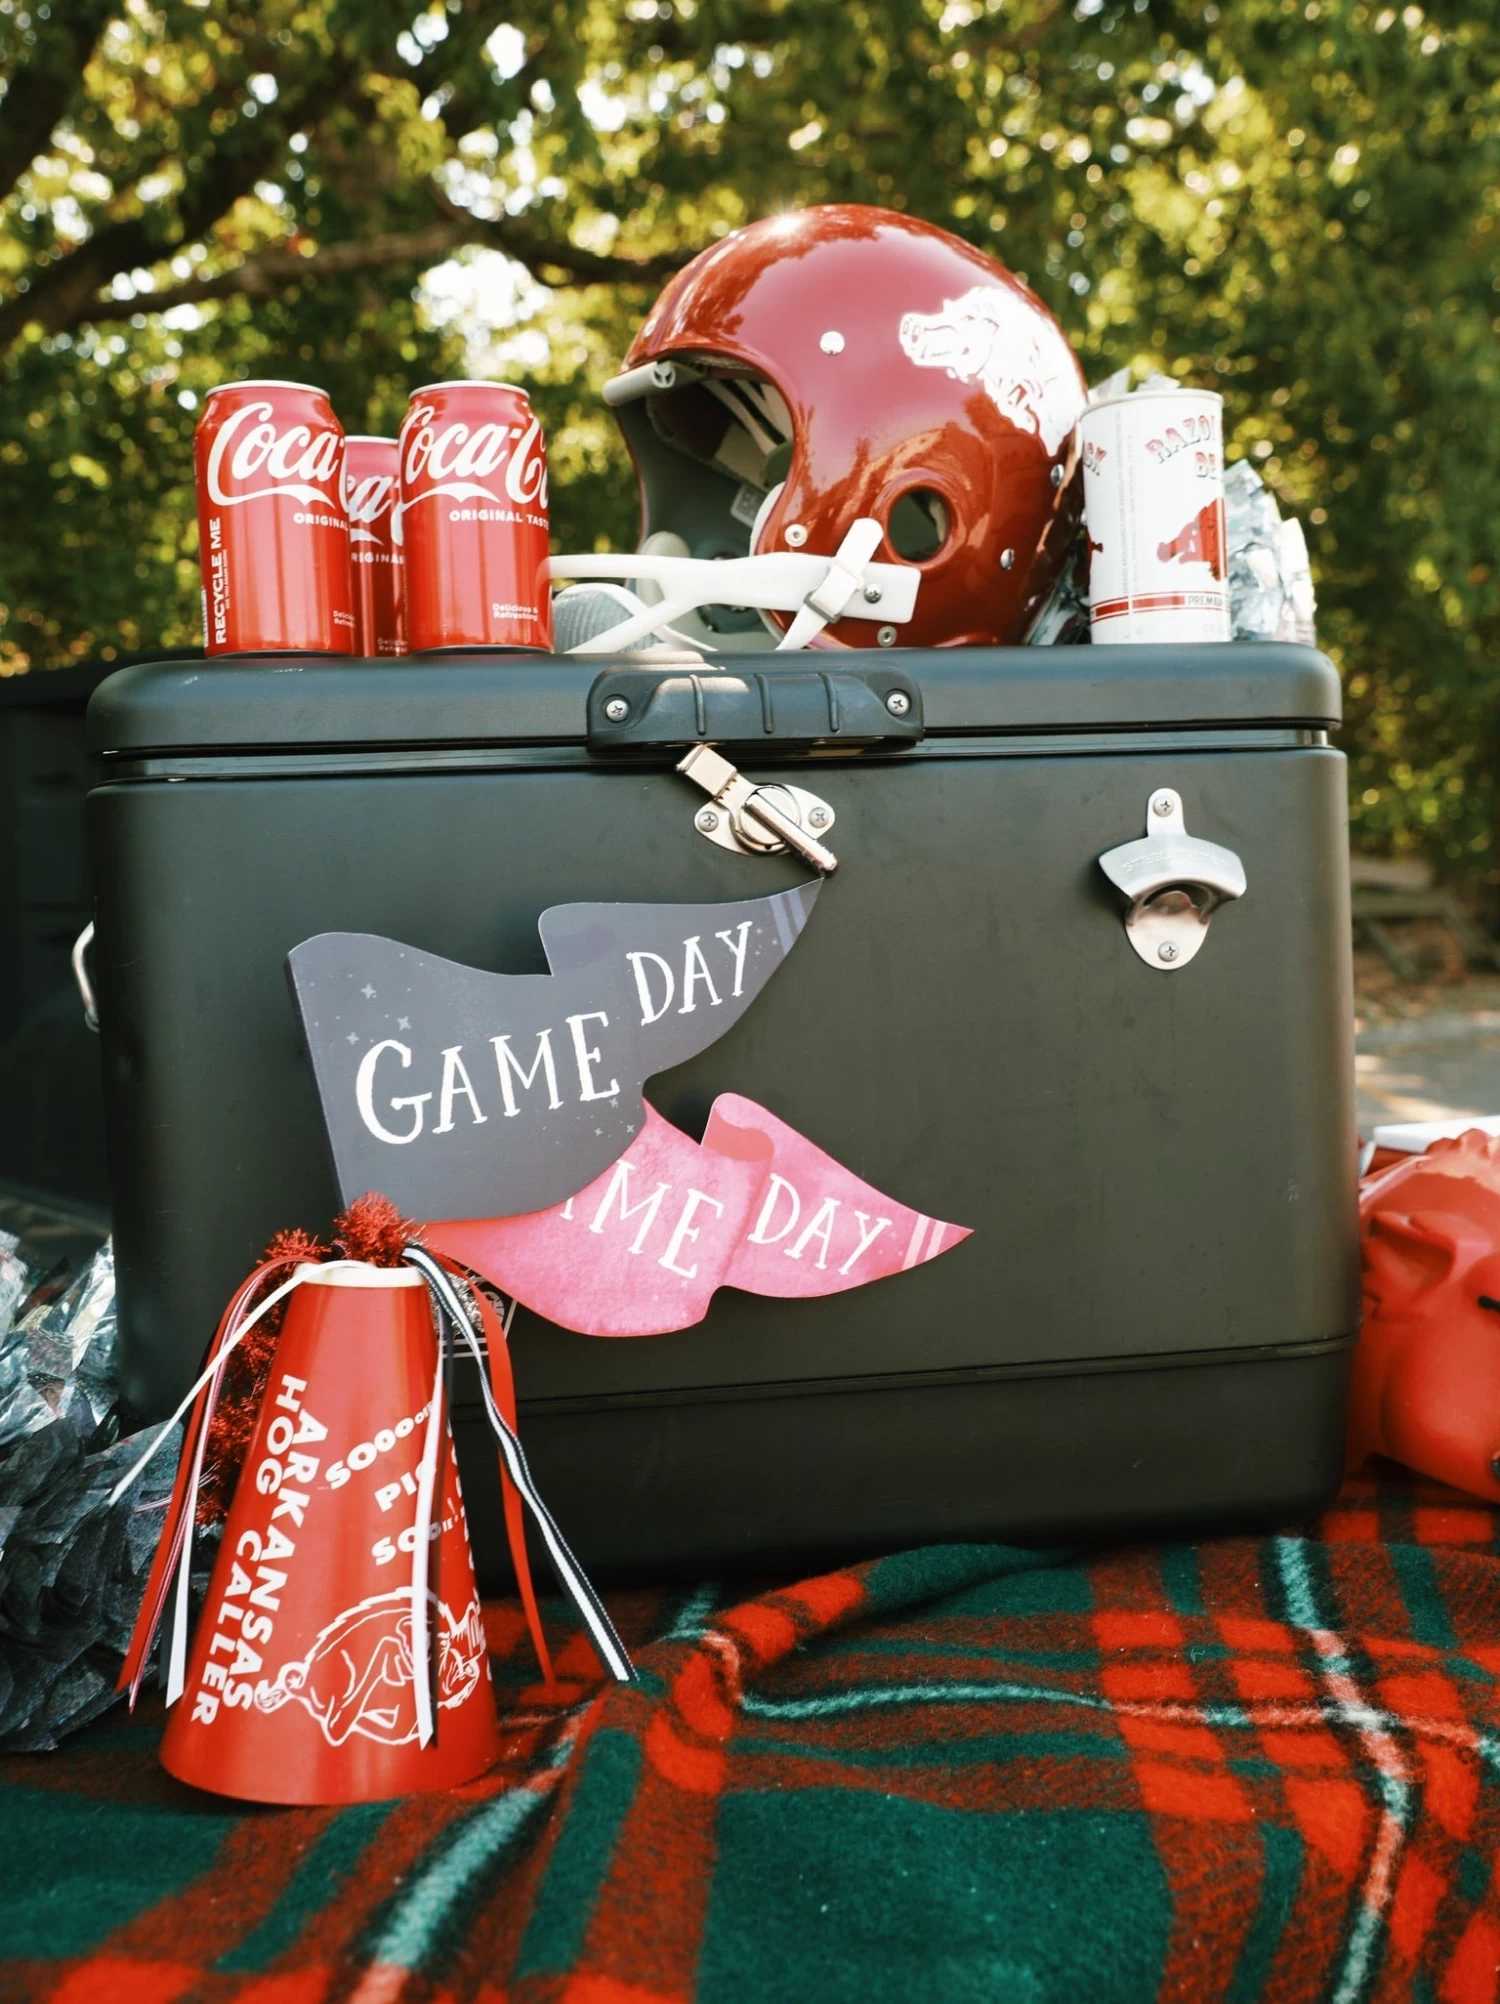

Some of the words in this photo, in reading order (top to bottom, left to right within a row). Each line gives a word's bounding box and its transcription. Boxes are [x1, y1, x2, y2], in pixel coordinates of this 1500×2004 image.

[1145, 415, 1215, 464] RAZO
[209, 517, 222, 549] ME
[449, 509, 523, 523] ORIGINAL
[211, 552, 227, 644] RECYCLE
[355, 1011, 620, 1145] GAME
[626, 921, 754, 1026] DAY
[559, 1159, 724, 1279] ME
[748, 1173, 893, 1275] DAY
[256, 1374, 308, 1497] HOG
[223, 1408, 329, 1711] ARKANSAS
[191, 1529, 262, 1725] CALLER
